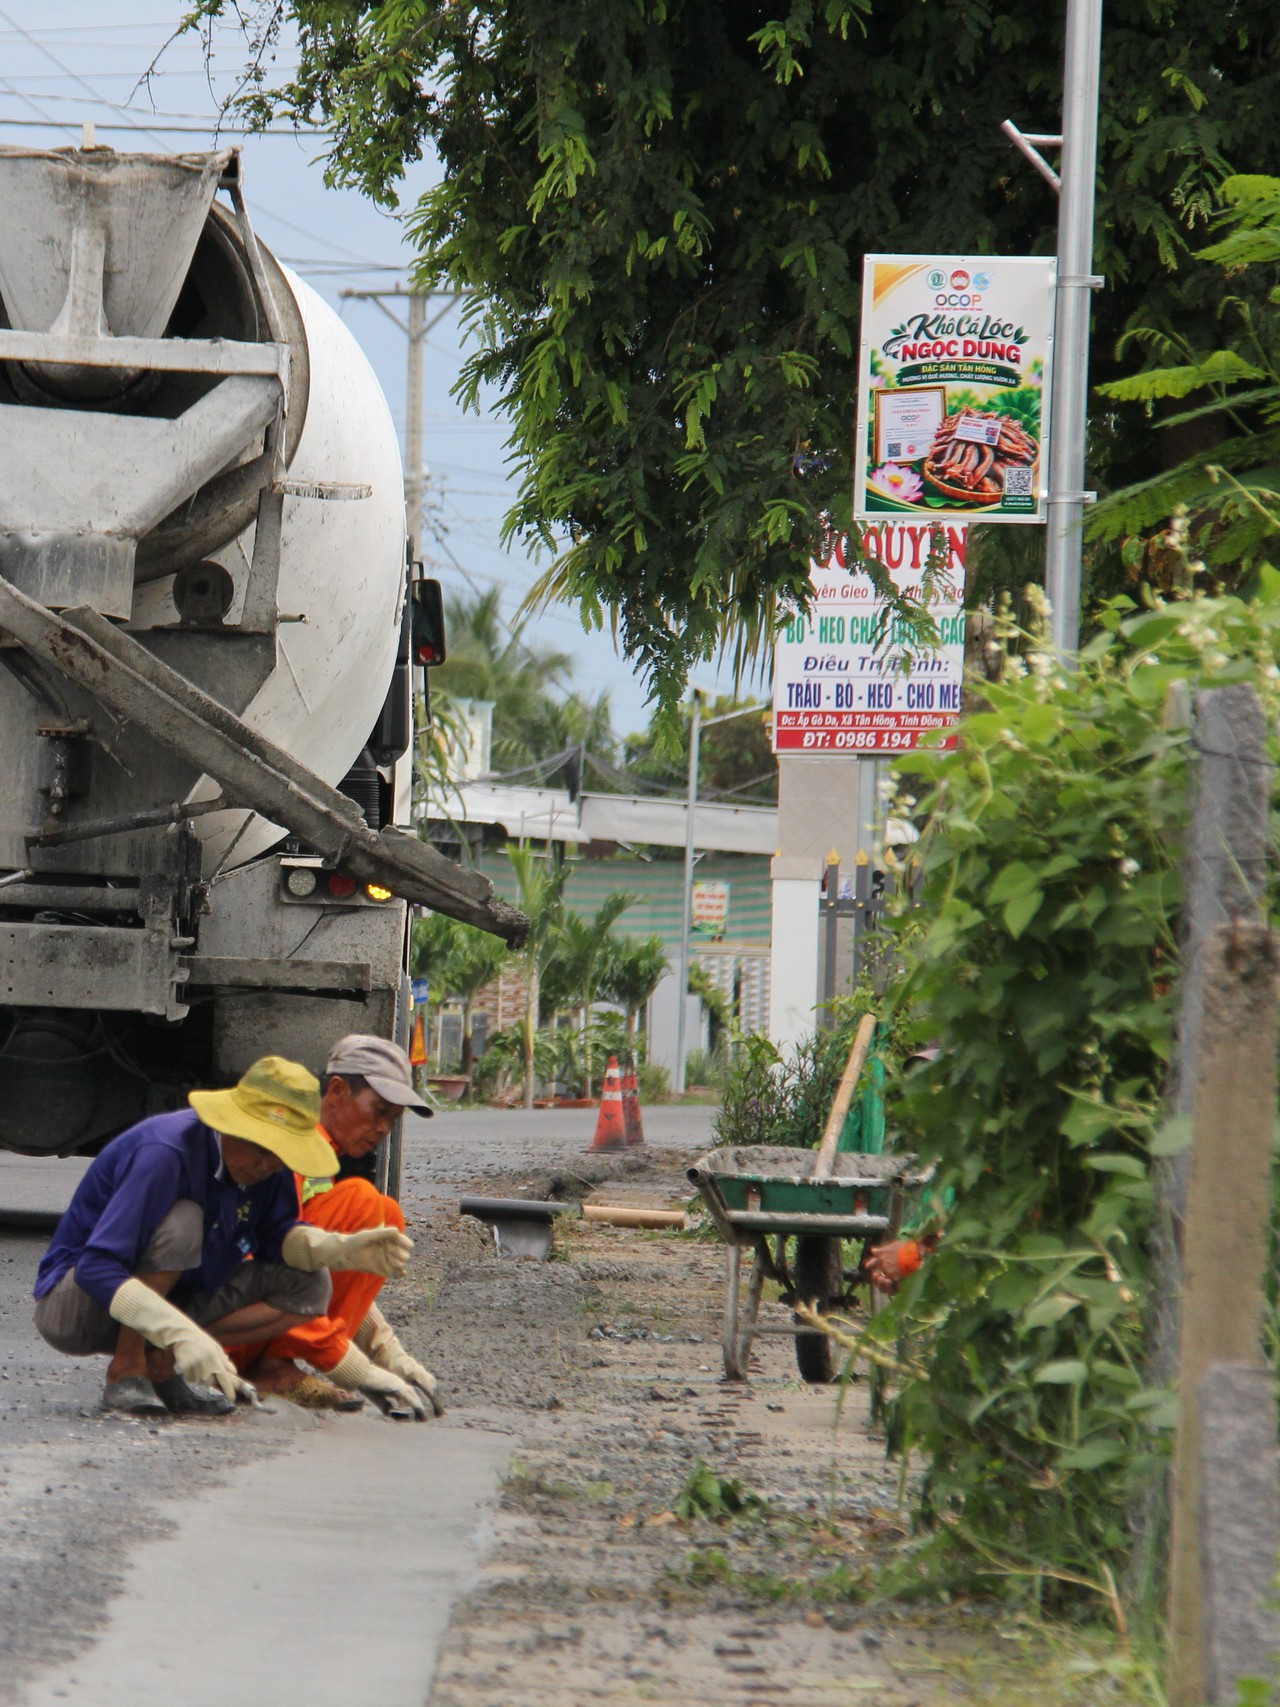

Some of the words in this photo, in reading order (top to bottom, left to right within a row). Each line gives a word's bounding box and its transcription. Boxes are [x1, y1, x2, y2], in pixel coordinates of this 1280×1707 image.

[936, 294, 982, 306] OCOP
[908, 313, 955, 340] Khô
[956, 314, 980, 337] Cá
[979, 315, 1014, 340] Lóc
[902, 340, 959, 363] NGỌC
[963, 340, 1022, 364] DUNG
[820, 616, 845, 644] HEO
[804, 653, 850, 671] Điều
[787, 678, 822, 708] TRÂU
[836, 678, 854, 708] BÒ
[868, 683, 892, 708] HEO
[907, 679, 934, 708] CHÓ
[811, 713, 823, 726] Gò
[841, 714, 853, 726] Xã
[855, 714, 871, 726] Tân
[873, 713, 897, 728] Hồng,
[900, 714, 918, 726] Tỉnh
[921, 714, 943, 727] Đồng
[802, 732, 831, 747] ĐT:
[835, 731, 876, 748] 0986
[881, 732, 912, 748] 194
